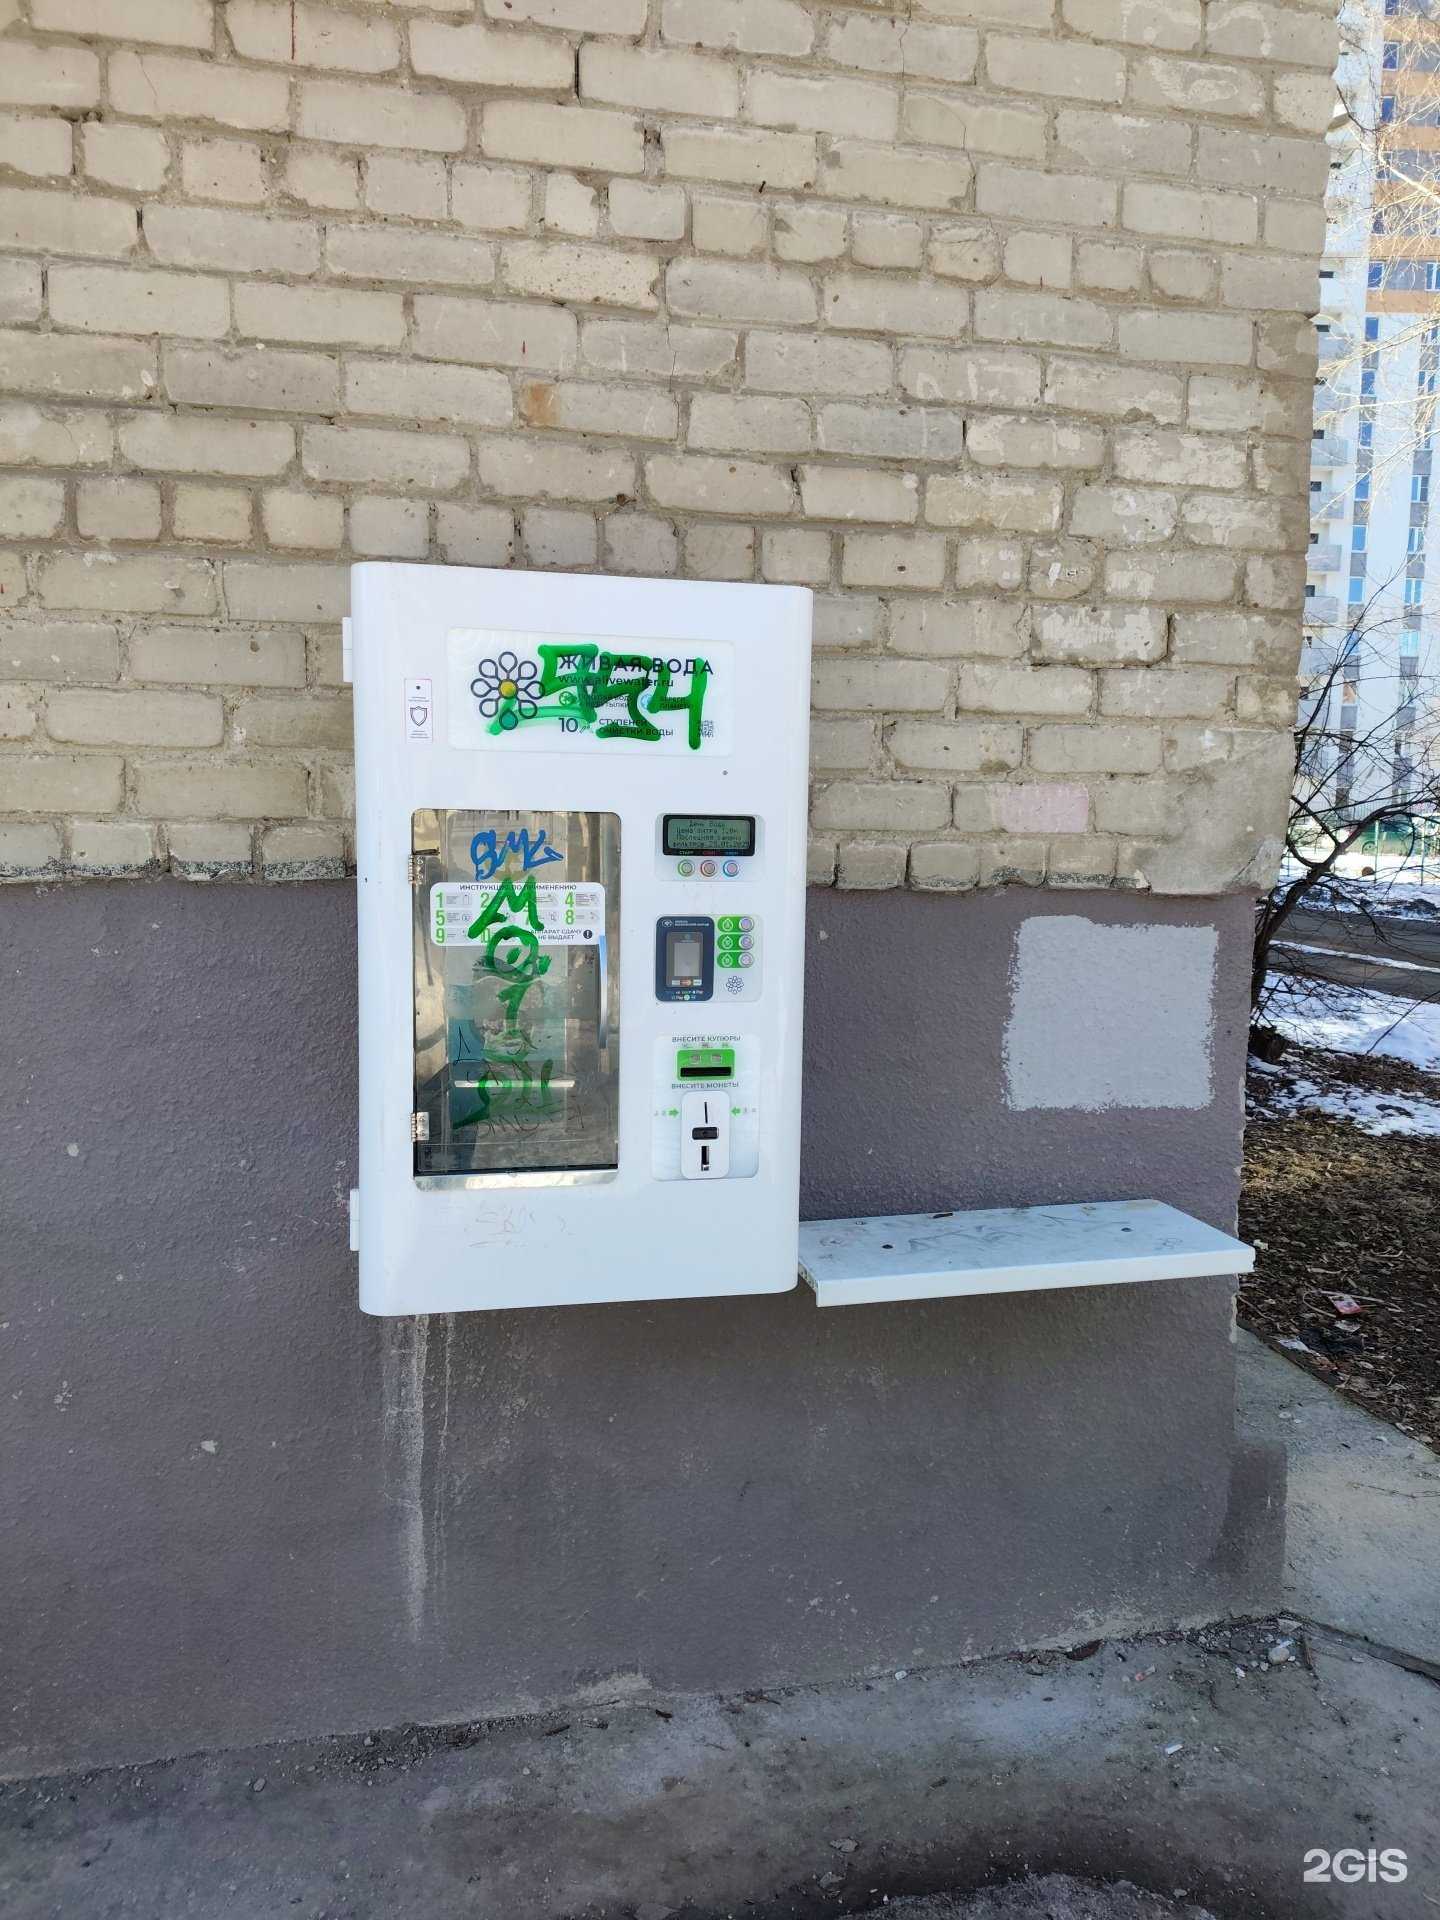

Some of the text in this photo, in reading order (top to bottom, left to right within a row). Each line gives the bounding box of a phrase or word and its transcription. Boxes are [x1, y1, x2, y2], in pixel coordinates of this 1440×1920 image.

[558, 654, 714, 676] ЖИВАЯ ВОДА
[558, 717, 579, 733] 10
[645, 728, 674, 737] ВОДЫ
[435, 892, 443, 909] 1
[480, 892, 490, 909] 2
[564, 892, 575, 908] 4
[435, 910, 446, 926] 5
[565, 909, 575, 925] 8
[435, 928, 445, 944] 9
